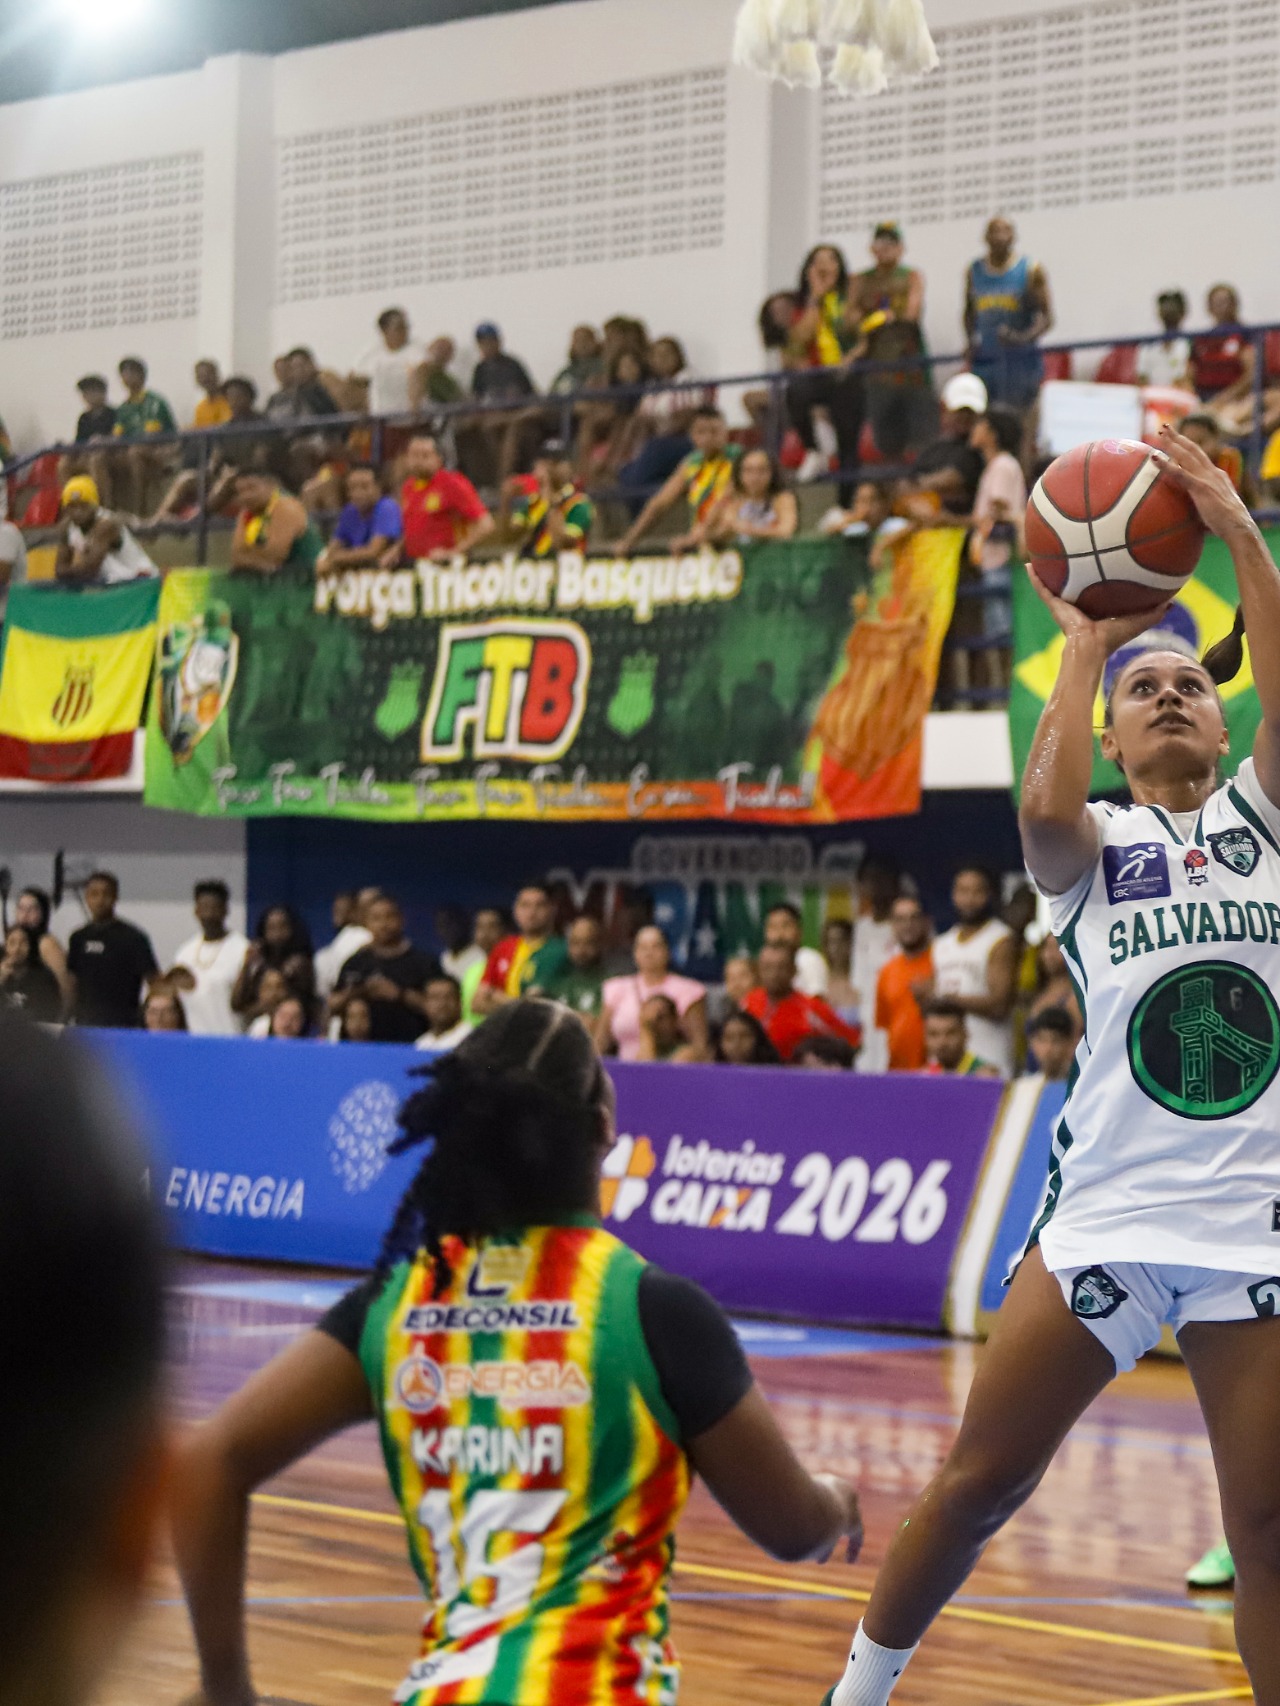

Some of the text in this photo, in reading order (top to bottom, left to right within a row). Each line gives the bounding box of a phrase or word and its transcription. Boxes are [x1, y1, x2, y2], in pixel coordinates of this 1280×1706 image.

[416, 555, 553, 617] Tricolor
[556, 548, 743, 622] Basquete
[427, 626, 585, 754] FTB
[1187, 865, 1208, 877] LBF
[663, 1133, 786, 1185] loterias
[165, 1166, 305, 1220] ENERGIA
[650, 1179, 772, 1232] CAIXA
[775, 1151, 952, 1245] 2026
[403, 1303, 579, 1330] EDECONSIL
[445, 1362, 587, 1392] ENERGIA
[411, 1423, 564, 1475] KARINA
[418, 1488, 570, 1638] 15
